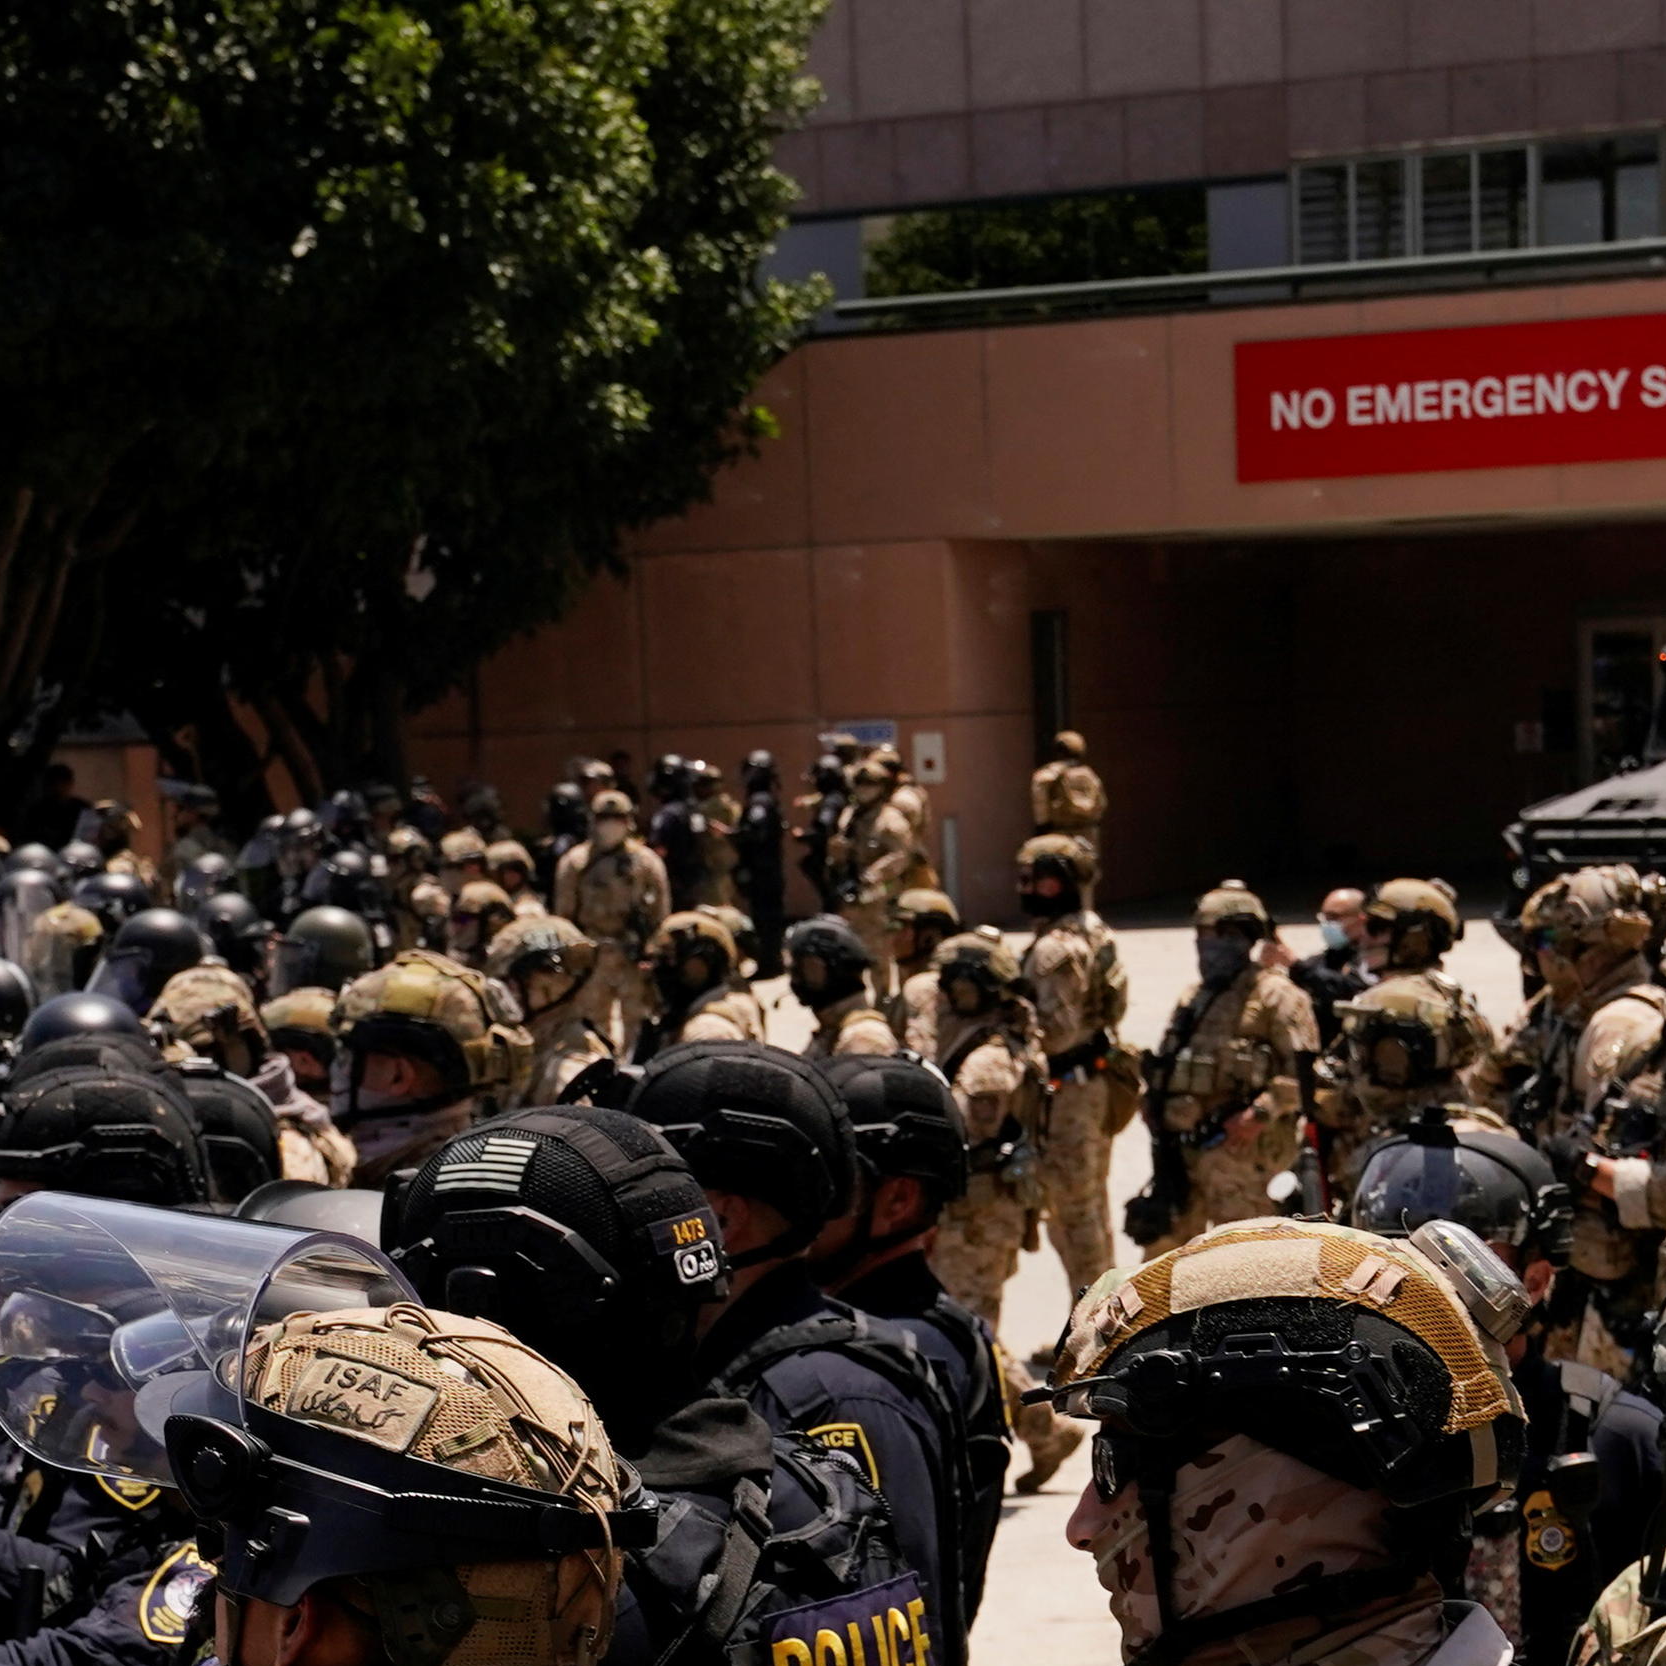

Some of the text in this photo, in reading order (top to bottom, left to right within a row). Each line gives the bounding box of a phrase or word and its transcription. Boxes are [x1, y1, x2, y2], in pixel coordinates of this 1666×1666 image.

[1270, 388, 1335, 430] NO
[1346, 369, 1630, 426] EMERGENCY
[673, 1217, 706, 1245] 1473
[324, 1363, 409, 1402] ISAF
